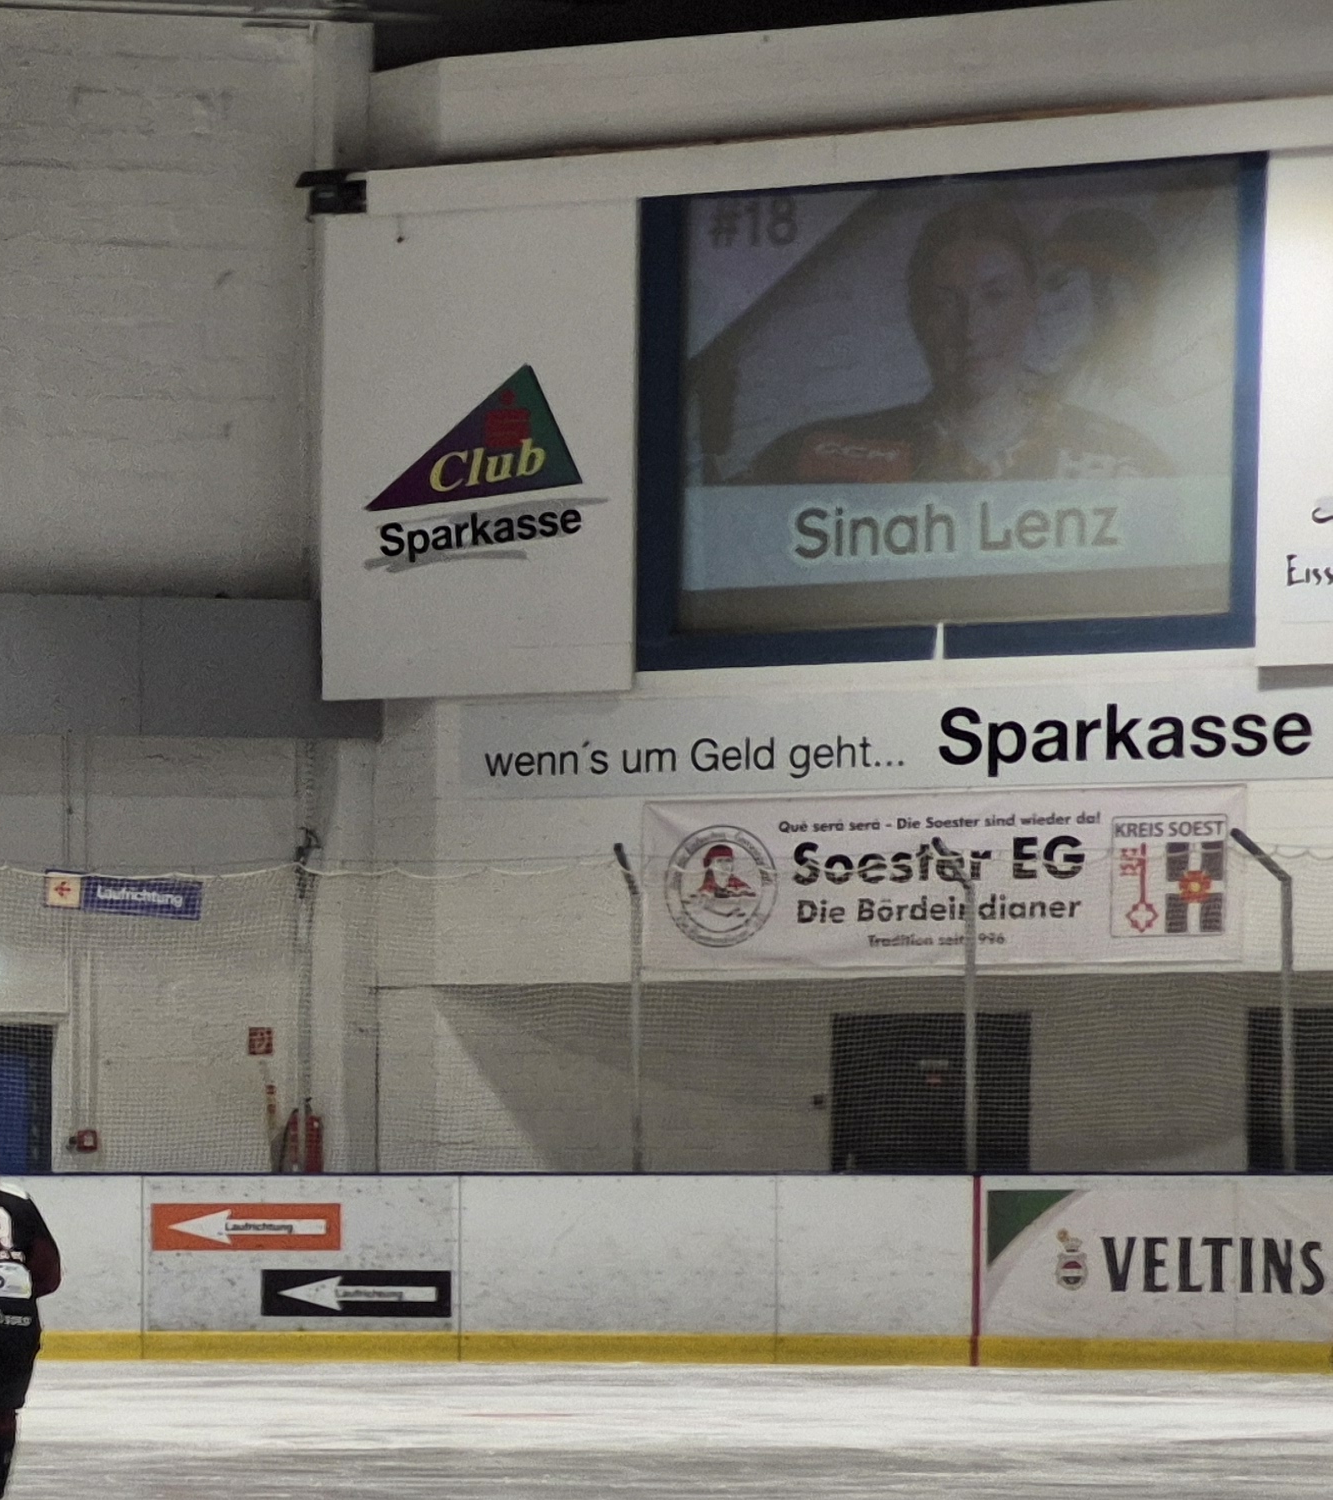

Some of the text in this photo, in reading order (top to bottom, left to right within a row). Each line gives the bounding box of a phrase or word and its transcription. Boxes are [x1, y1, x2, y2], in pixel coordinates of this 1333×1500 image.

[706, 197, 799, 249] #18
[429, 437, 547, 493] Club
[380, 506, 583, 562] Sparkasse
[793, 502, 1121, 560] Sinah Lenz
[621, 747, 678, 775] um
[690, 735, 775, 773] Geld
[789, 735, 905, 779] geht...
[938, 703, 1314, 778] Sparkasse
[896, 817, 921, 830] Die
[925, 815, 981, 829] Soester
[984, 813, 1016, 827] sind
[1020, 812, 1072, 826] wieder
[1076, 810, 1101, 825] da!
[1114, 819, 1226, 838] KREIS SOEST
[792, 835, 1086, 886] Soester EG
[96, 884, 184, 910] Laufrichtung
[796, 898, 846, 925] Die
[224, 1221, 294, 1234] Laufrichtung
[1101, 1235, 1326, 1296] VELTINS
